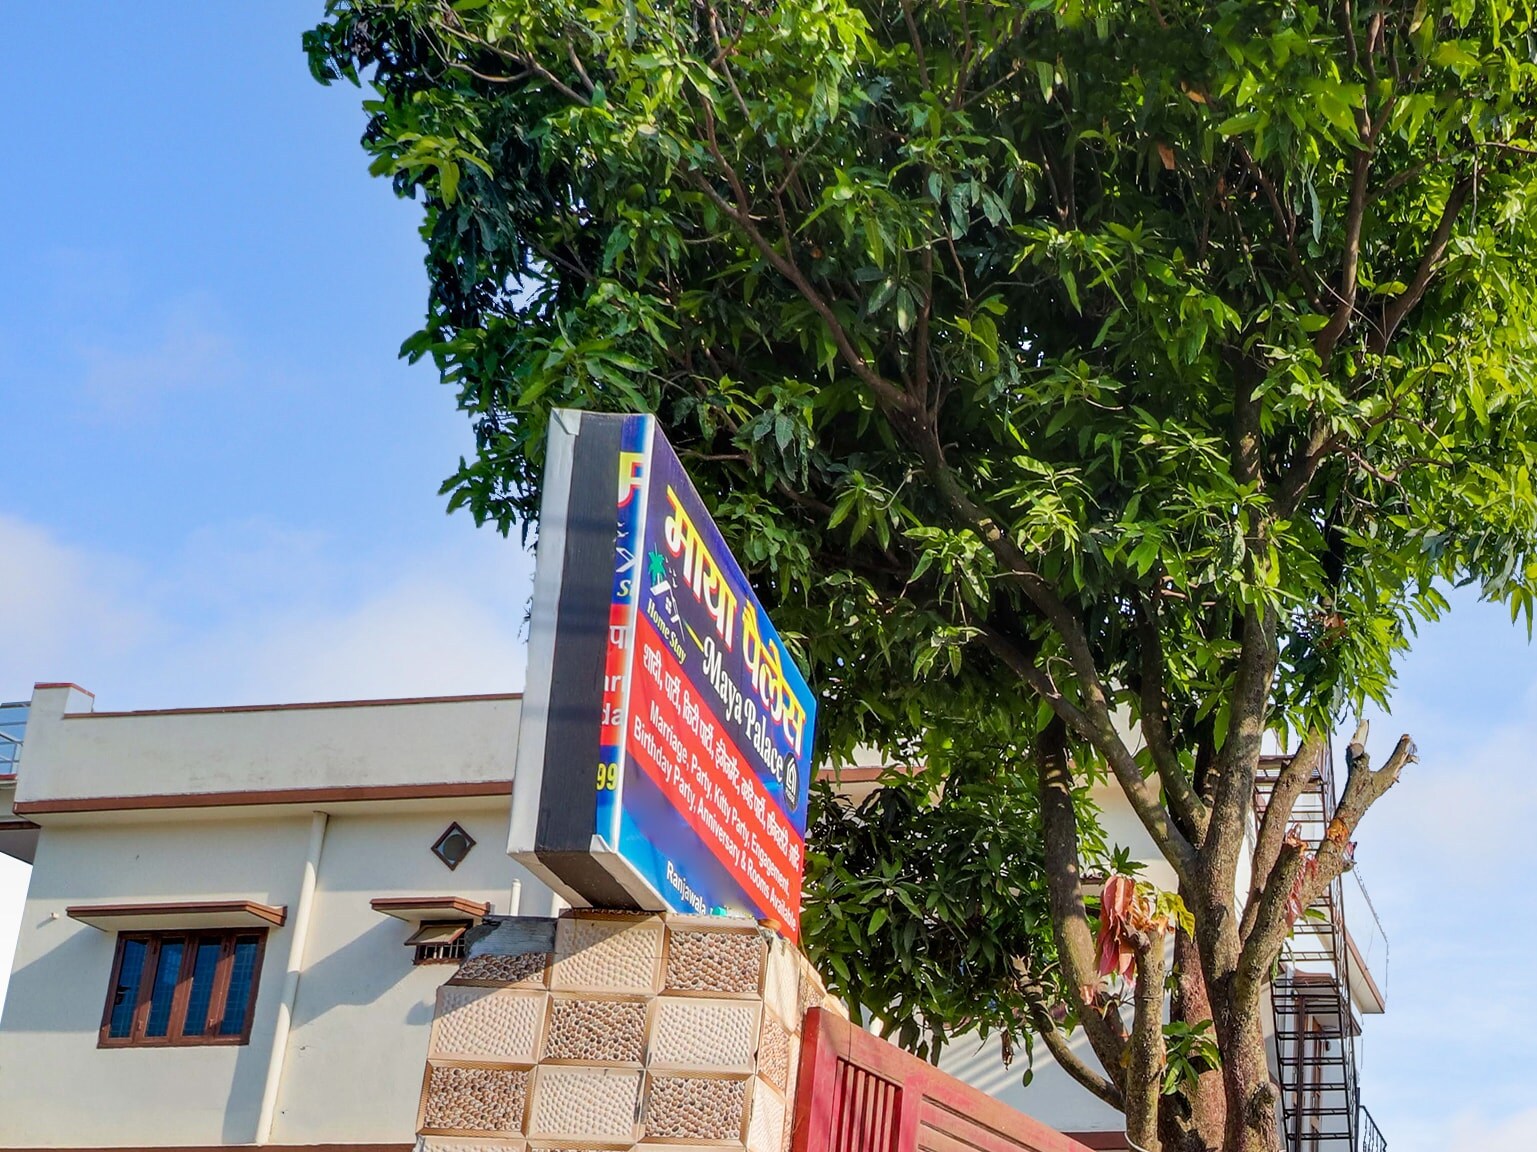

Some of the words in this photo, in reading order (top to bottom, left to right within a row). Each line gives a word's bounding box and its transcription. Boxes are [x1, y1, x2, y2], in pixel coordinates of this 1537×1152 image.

[643, 643, 663, 690] शादी,
[647, 598, 670, 639] Home
[669, 631, 686, 665] Stay
[664, 484, 737, 653] माया
[742, 598, 806, 758] पैलेस
[702, 636, 742, 725] Maya
[744, 698, 784, 782] Palace
[634, 714, 672, 782] Birthday
[672, 764, 697, 812] Party,
[697, 797, 740, 867] Anniversary
[740, 851, 747, 872] &
[747, 857, 770, 899] Rooms
[770, 889, 797, 932] Available
[650, 699, 690, 770] Marriage,
[691, 753, 712, 801] Party,
[714, 783, 731, 823] Kitty
[732, 806, 750, 848] Party,
[751, 832, 790, 897] Engagement,
[666, 860, 706, 914] Ranjawala
